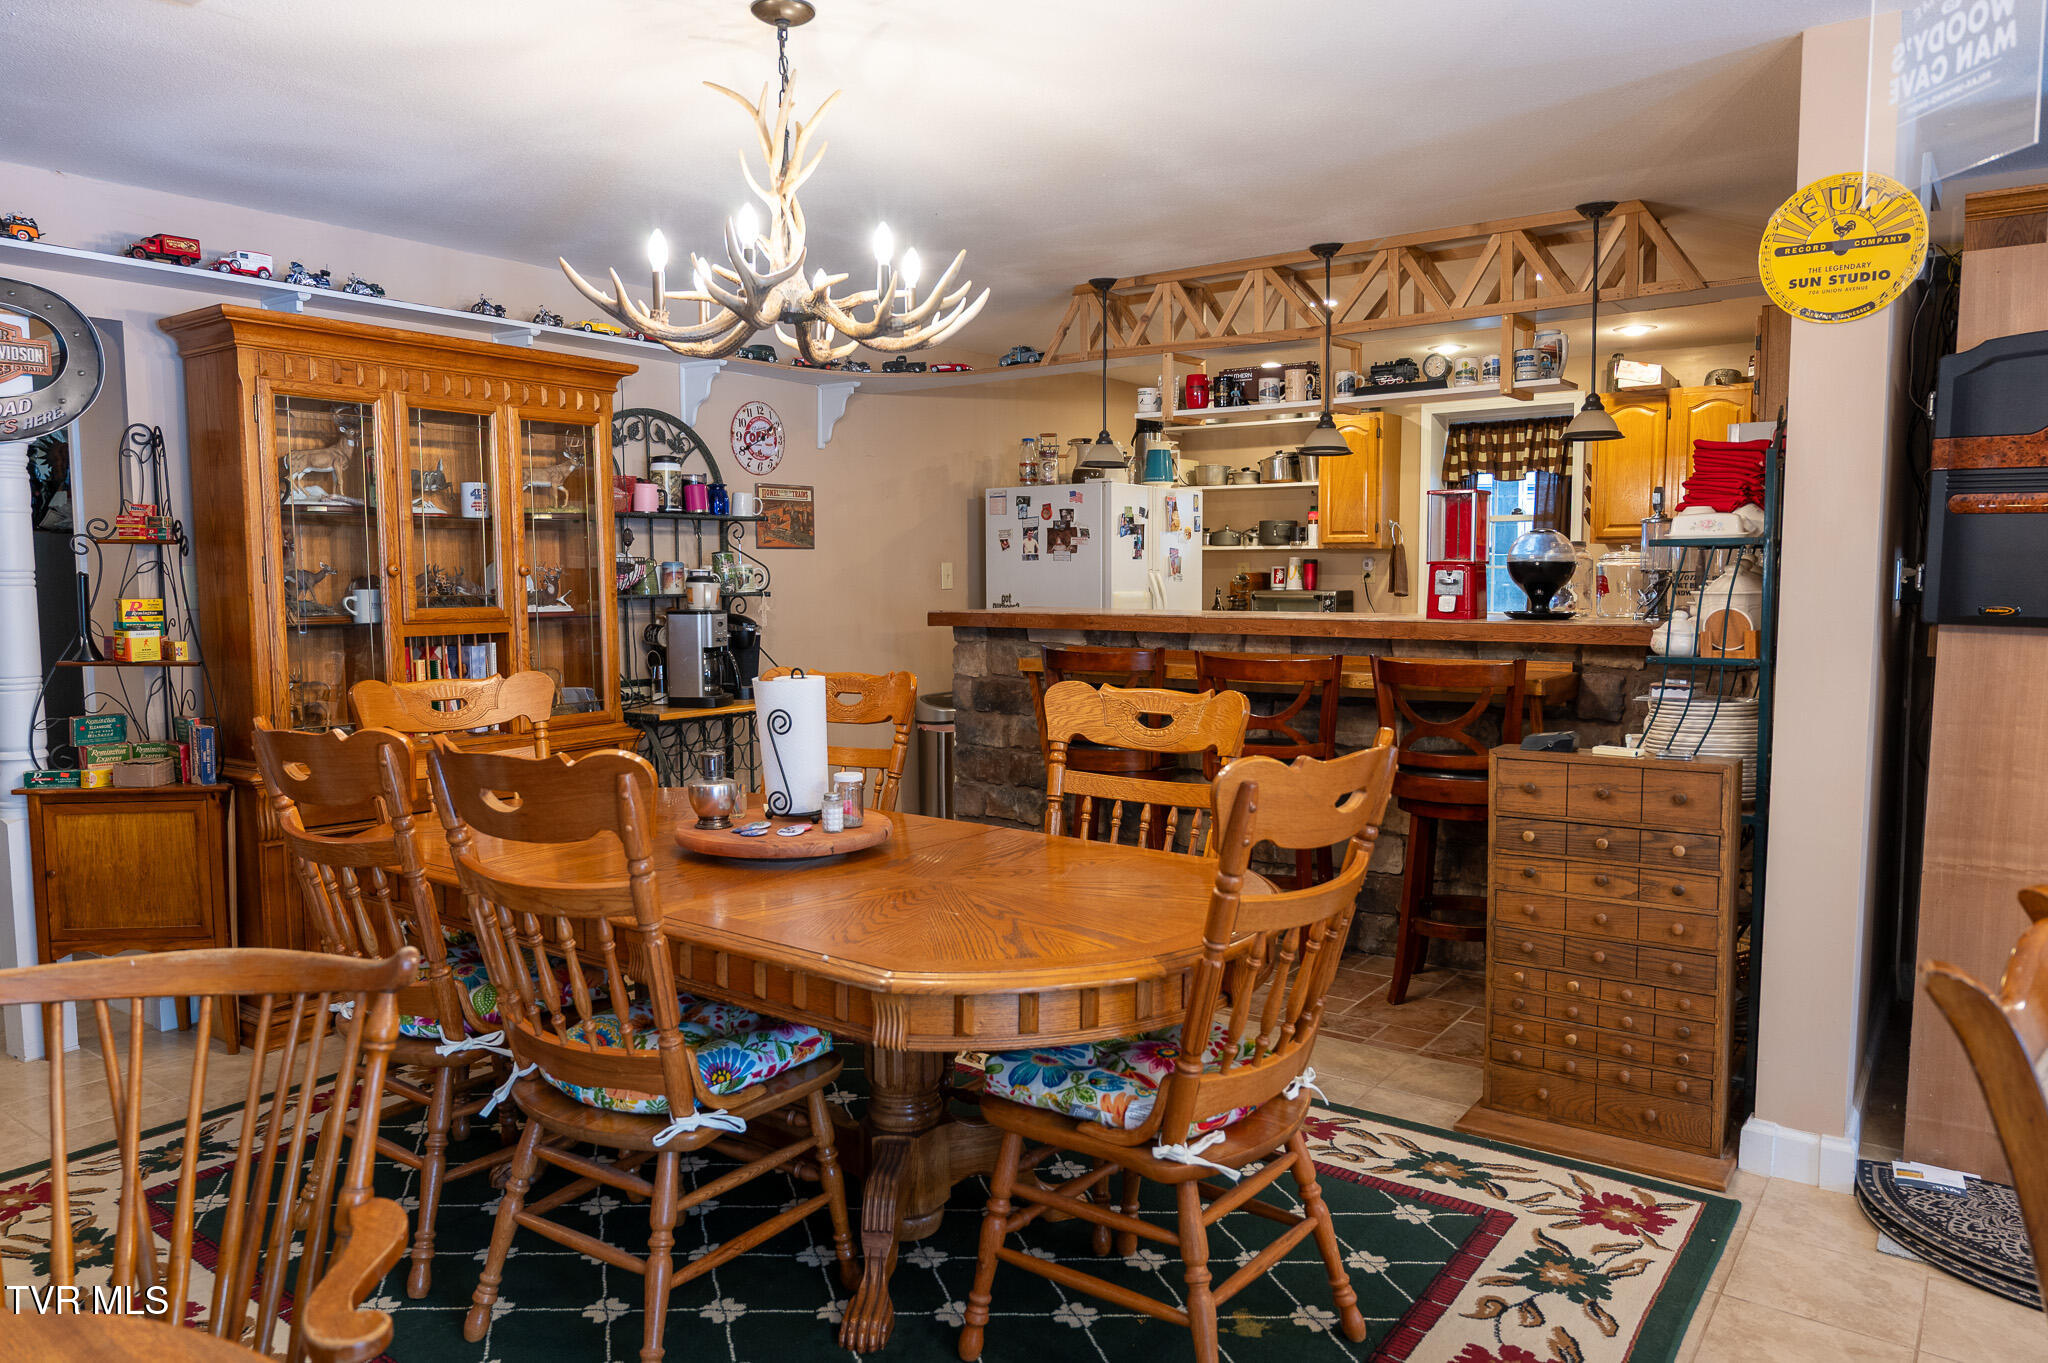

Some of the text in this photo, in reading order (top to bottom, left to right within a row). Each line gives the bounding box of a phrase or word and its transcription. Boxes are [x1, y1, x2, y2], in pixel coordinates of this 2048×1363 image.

[1799, 184, 1895, 222] SUN
[1784, 235, 1904, 254] RECORD COMPANY
[1825, 261, 1872, 273] LEGENDARY
[1788, 269, 1891, 290] SUN STUDIO
[1822, 287, 1843, 295] UNION
[747, 408, 753, 417] 11
[757, 406, 764, 415] 12
[738, 418, 746, 427] 10
[736, 431, 742, 441] 9
[739, 446, 746, 456] 8
[747, 458, 753, 467] 7
[757, 462, 763, 472] 6
